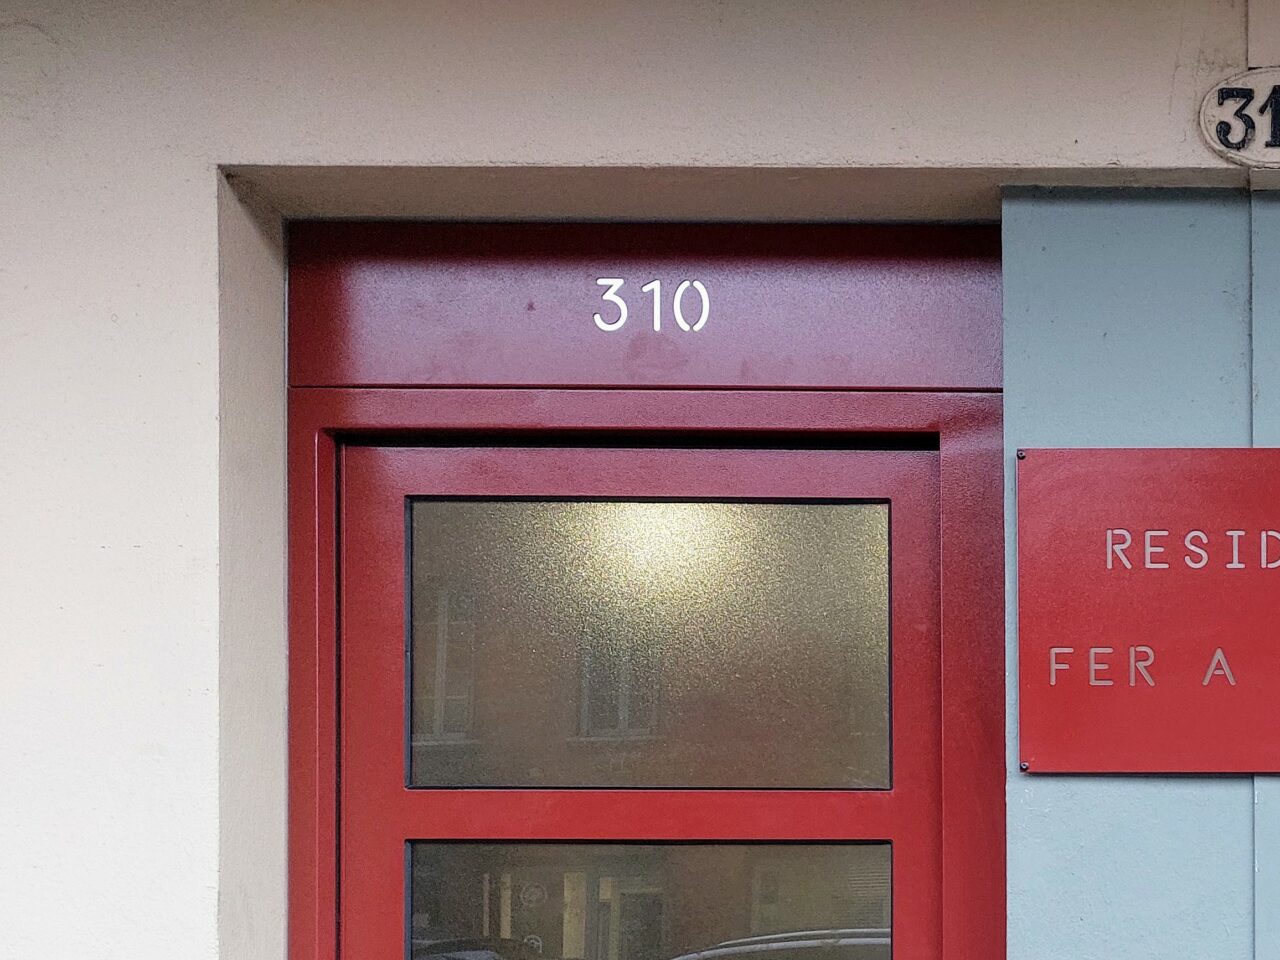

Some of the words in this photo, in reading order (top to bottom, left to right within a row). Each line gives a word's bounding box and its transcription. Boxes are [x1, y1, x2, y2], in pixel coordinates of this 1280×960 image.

[593, 278, 710, 332] 310
[1049, 646, 1156, 687] FER
[1202, 647, 1237, 686] A
